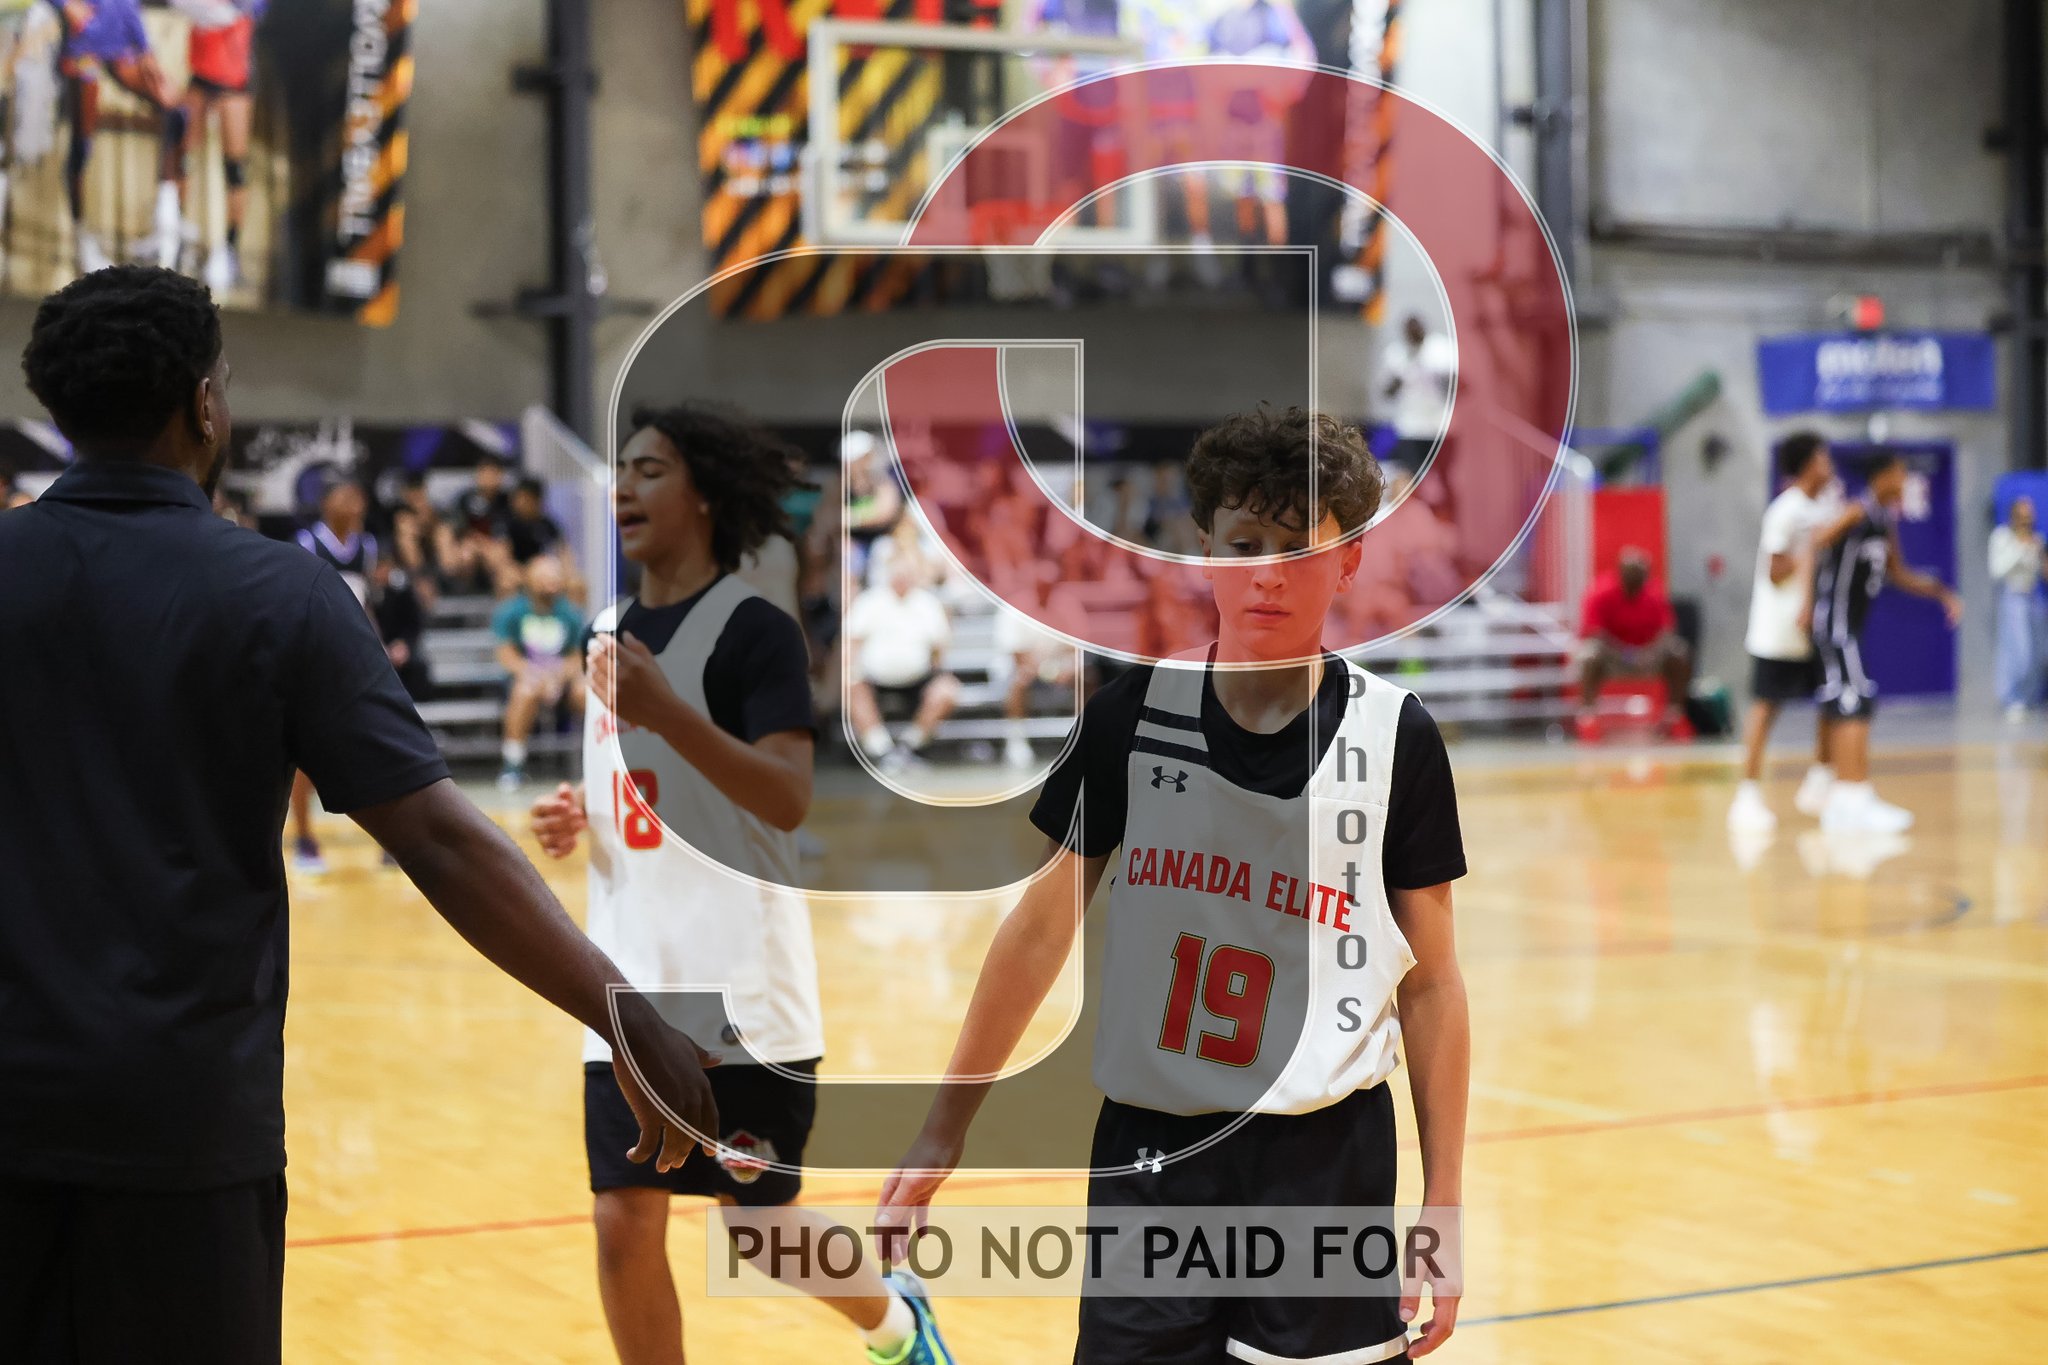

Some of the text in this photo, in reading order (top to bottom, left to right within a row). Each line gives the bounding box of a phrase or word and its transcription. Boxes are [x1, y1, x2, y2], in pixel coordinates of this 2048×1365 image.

[1128, 847, 1355, 933] CANADA ELITE
[1157, 931, 1275, 1068] 19
